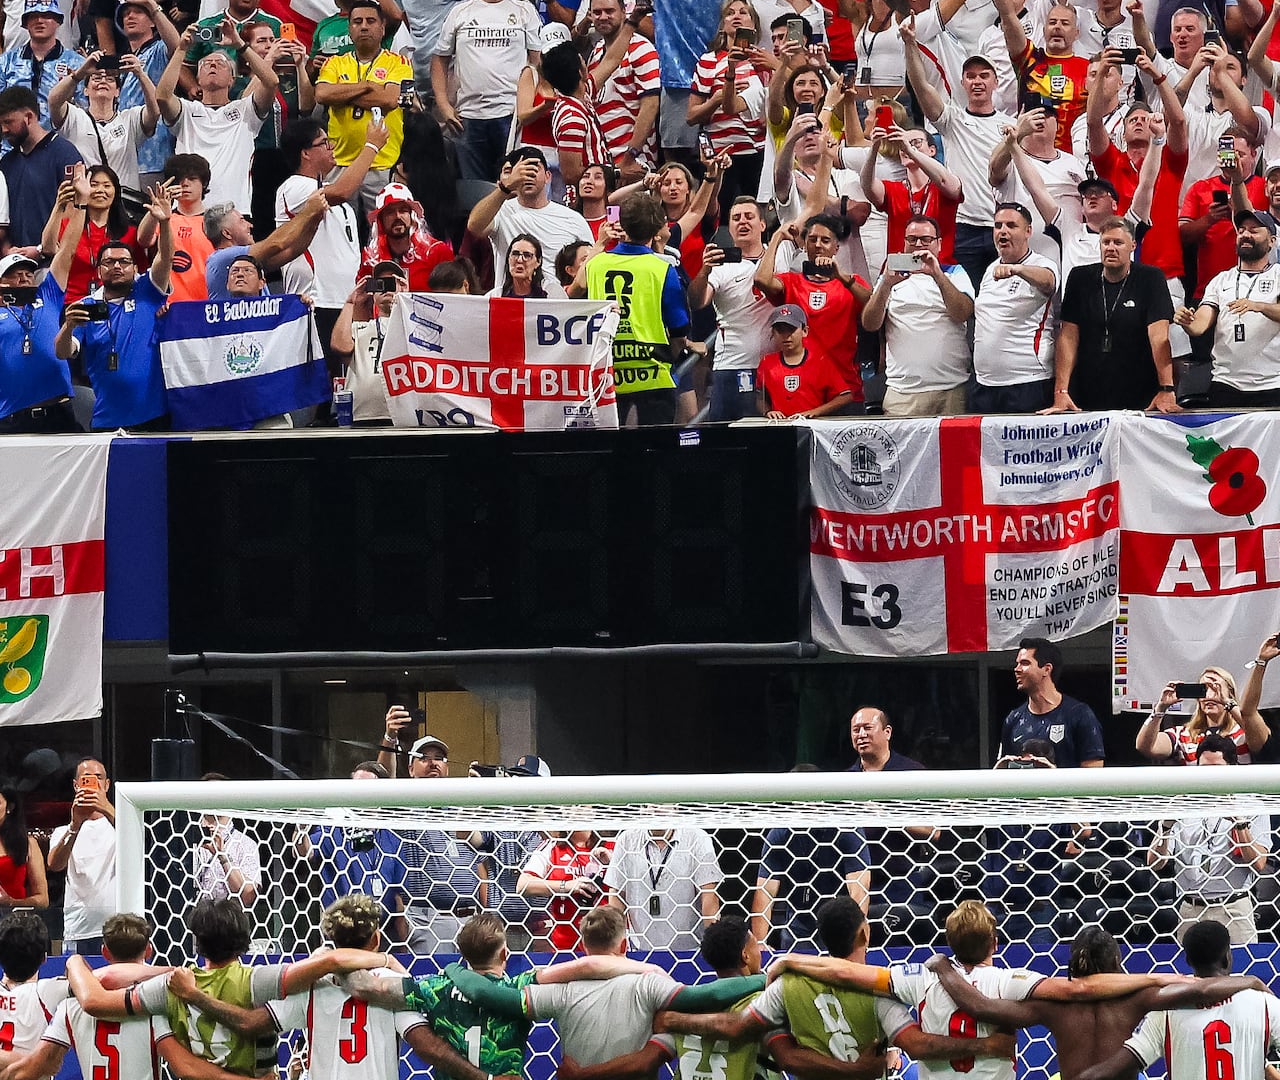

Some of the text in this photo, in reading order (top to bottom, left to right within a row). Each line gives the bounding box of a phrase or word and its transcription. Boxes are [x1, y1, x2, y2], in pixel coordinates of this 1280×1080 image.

[467, 26, 518, 40] Emirates
[545, 30, 566, 41] USA
[223, 297, 283, 322] Salvador
[1001, 423, 1058, 441] Johnnie
[1004, 440, 1104, 466] Football Write
[811, 514, 993, 554] WENTWORTH
[1000, 509, 1081, 545] ARMS
[1072, 555, 1090, 573] OF
[841, 579, 902, 630] E3
[990, 588, 1019, 602] END
[1021, 585, 1048, 601] AND
[996, 583, 1118, 622] YOU'LL NEVER SING
[338, 996, 369, 1064] 3
[92, 1019, 121, 1080] 5
[464, 1024, 482, 1070] 1
[1202, 1019, 1236, 1080] 6
